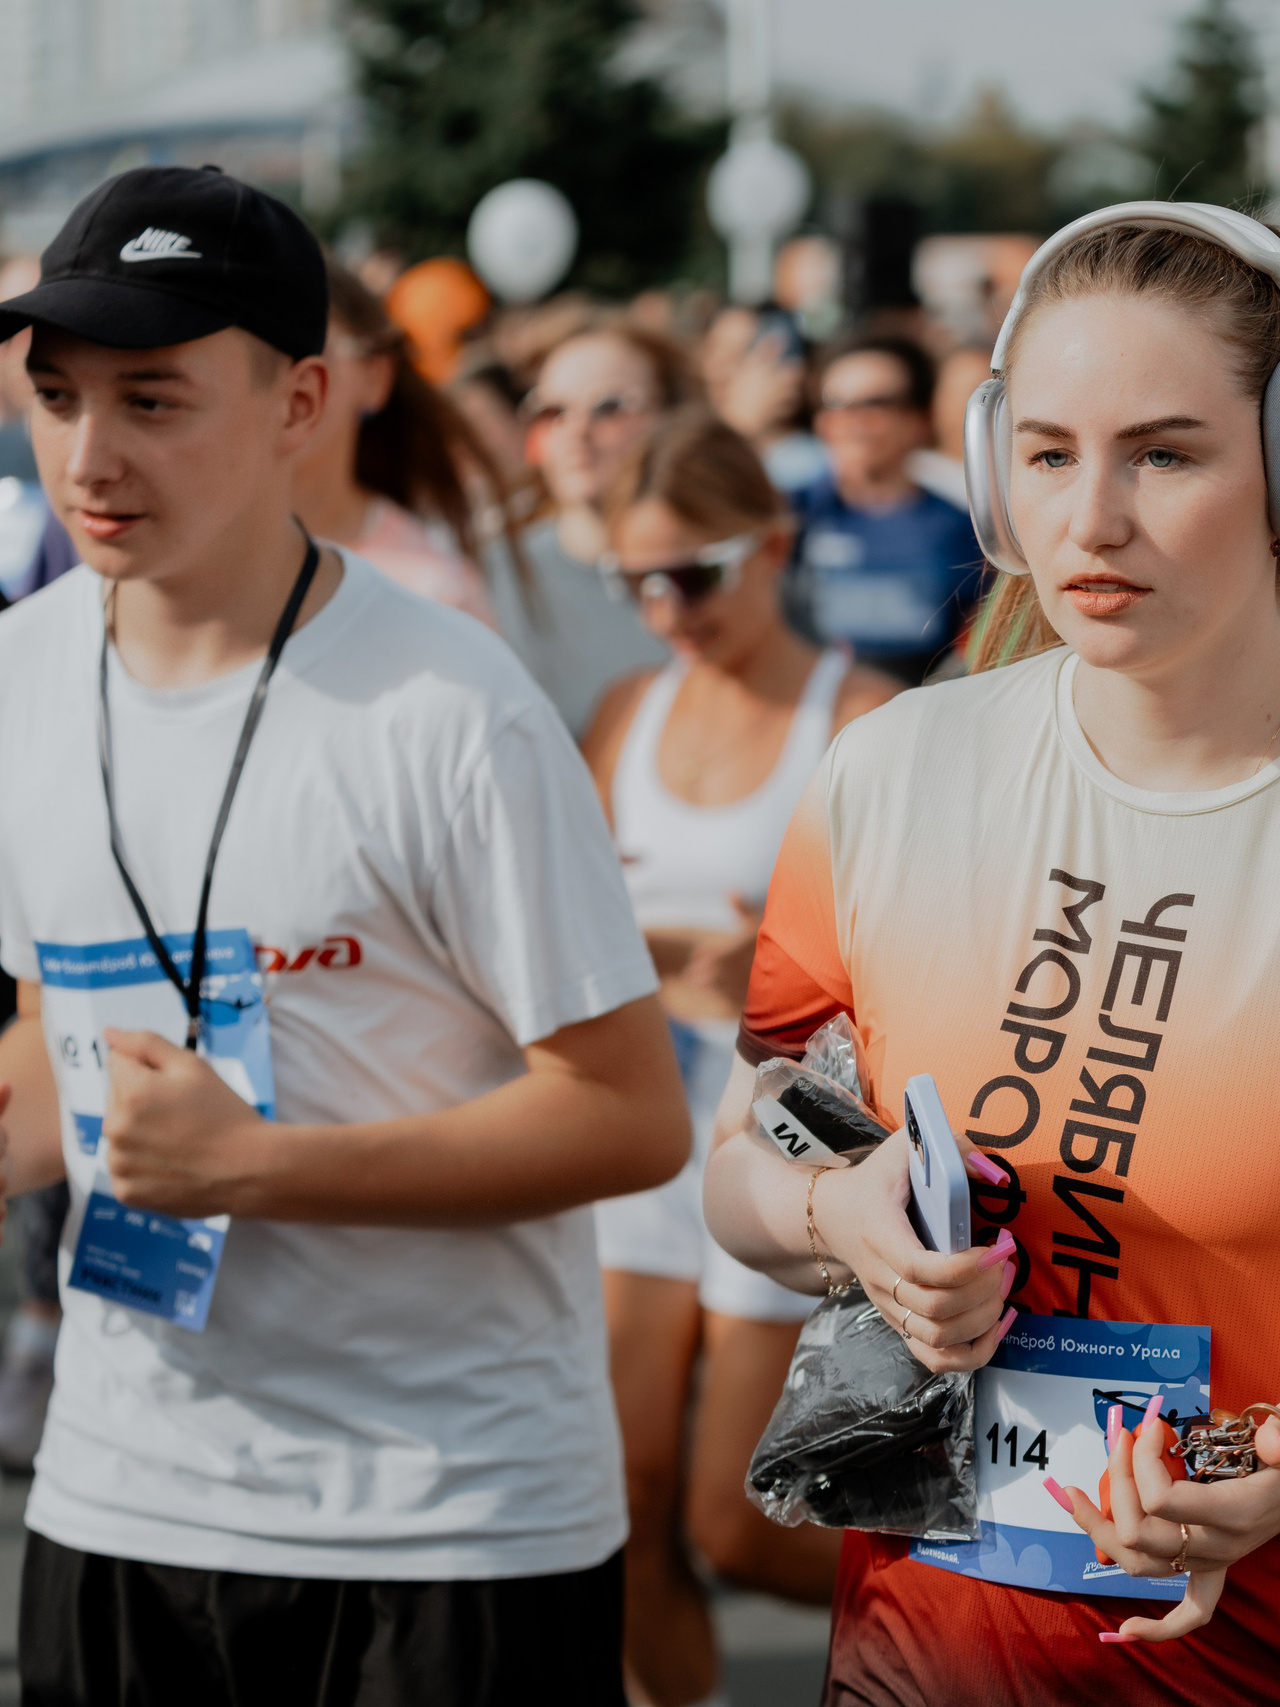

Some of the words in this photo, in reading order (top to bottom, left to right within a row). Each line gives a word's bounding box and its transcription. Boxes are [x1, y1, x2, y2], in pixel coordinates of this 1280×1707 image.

[133, 225, 192, 252] NIKE
[965, 868, 1106, 1316] МАРАФО
[1061, 1338, 1125, 1357] Южного
[1131, 1343, 1181, 1360] Урала
[986, 1422, 1049, 1471] 114
